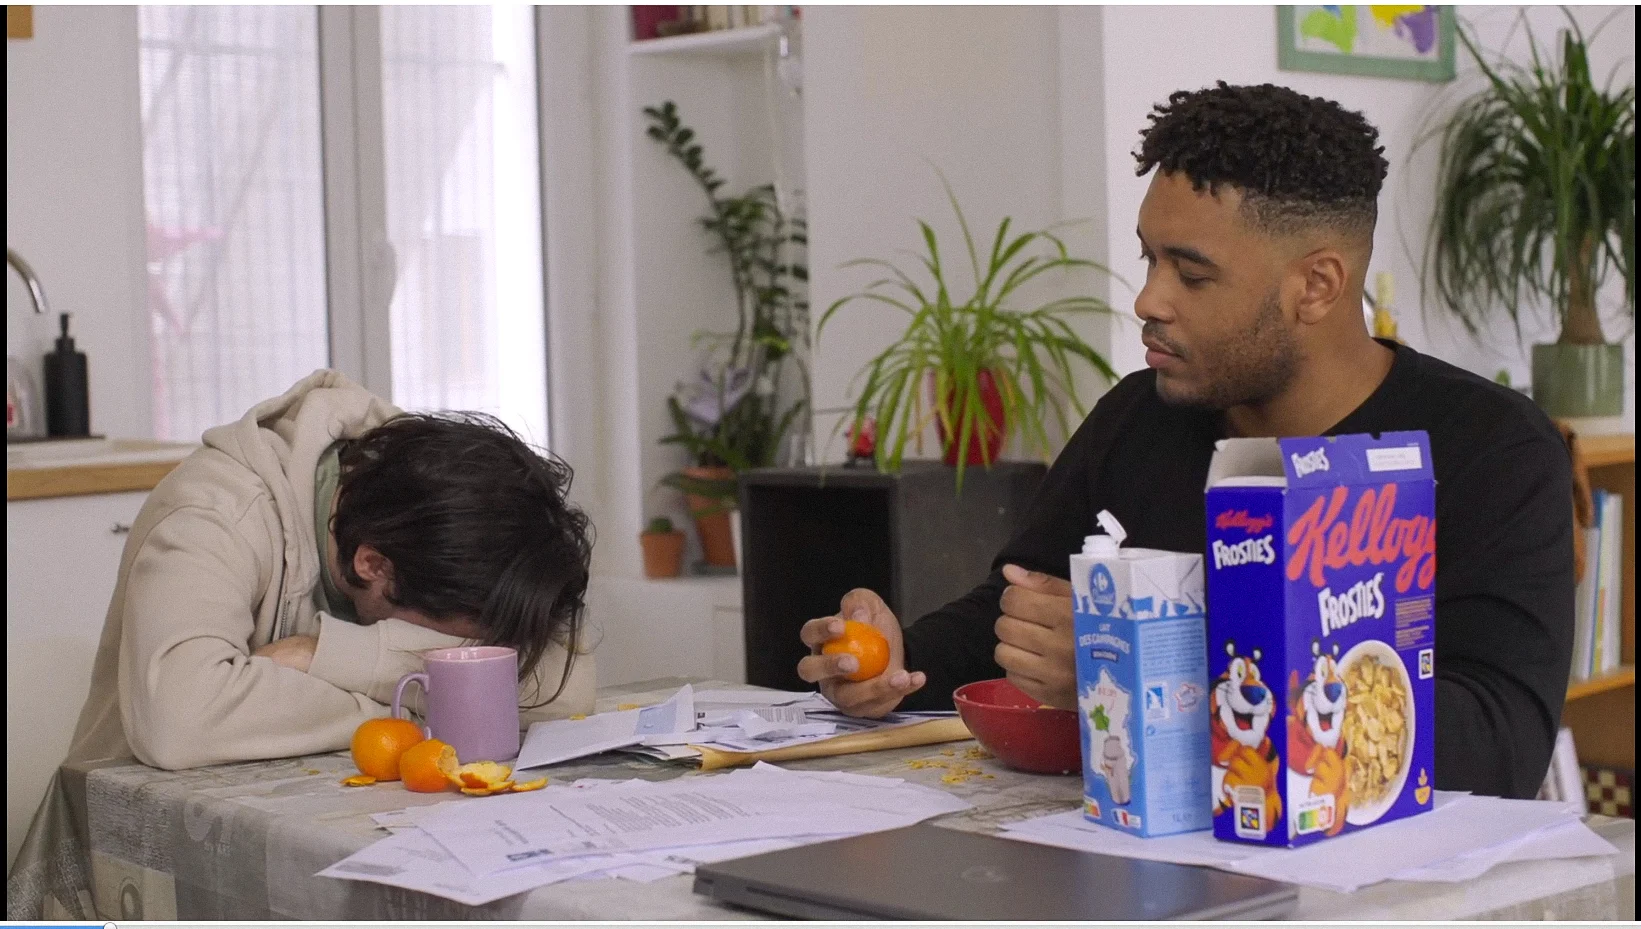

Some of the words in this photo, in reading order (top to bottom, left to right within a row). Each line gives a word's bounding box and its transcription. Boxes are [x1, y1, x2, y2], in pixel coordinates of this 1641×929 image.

[1290, 446, 1330, 478] FROSTIES
[1212, 534, 1276, 570] FROSTIES
[1317, 571, 1385, 638] FROSTIES
